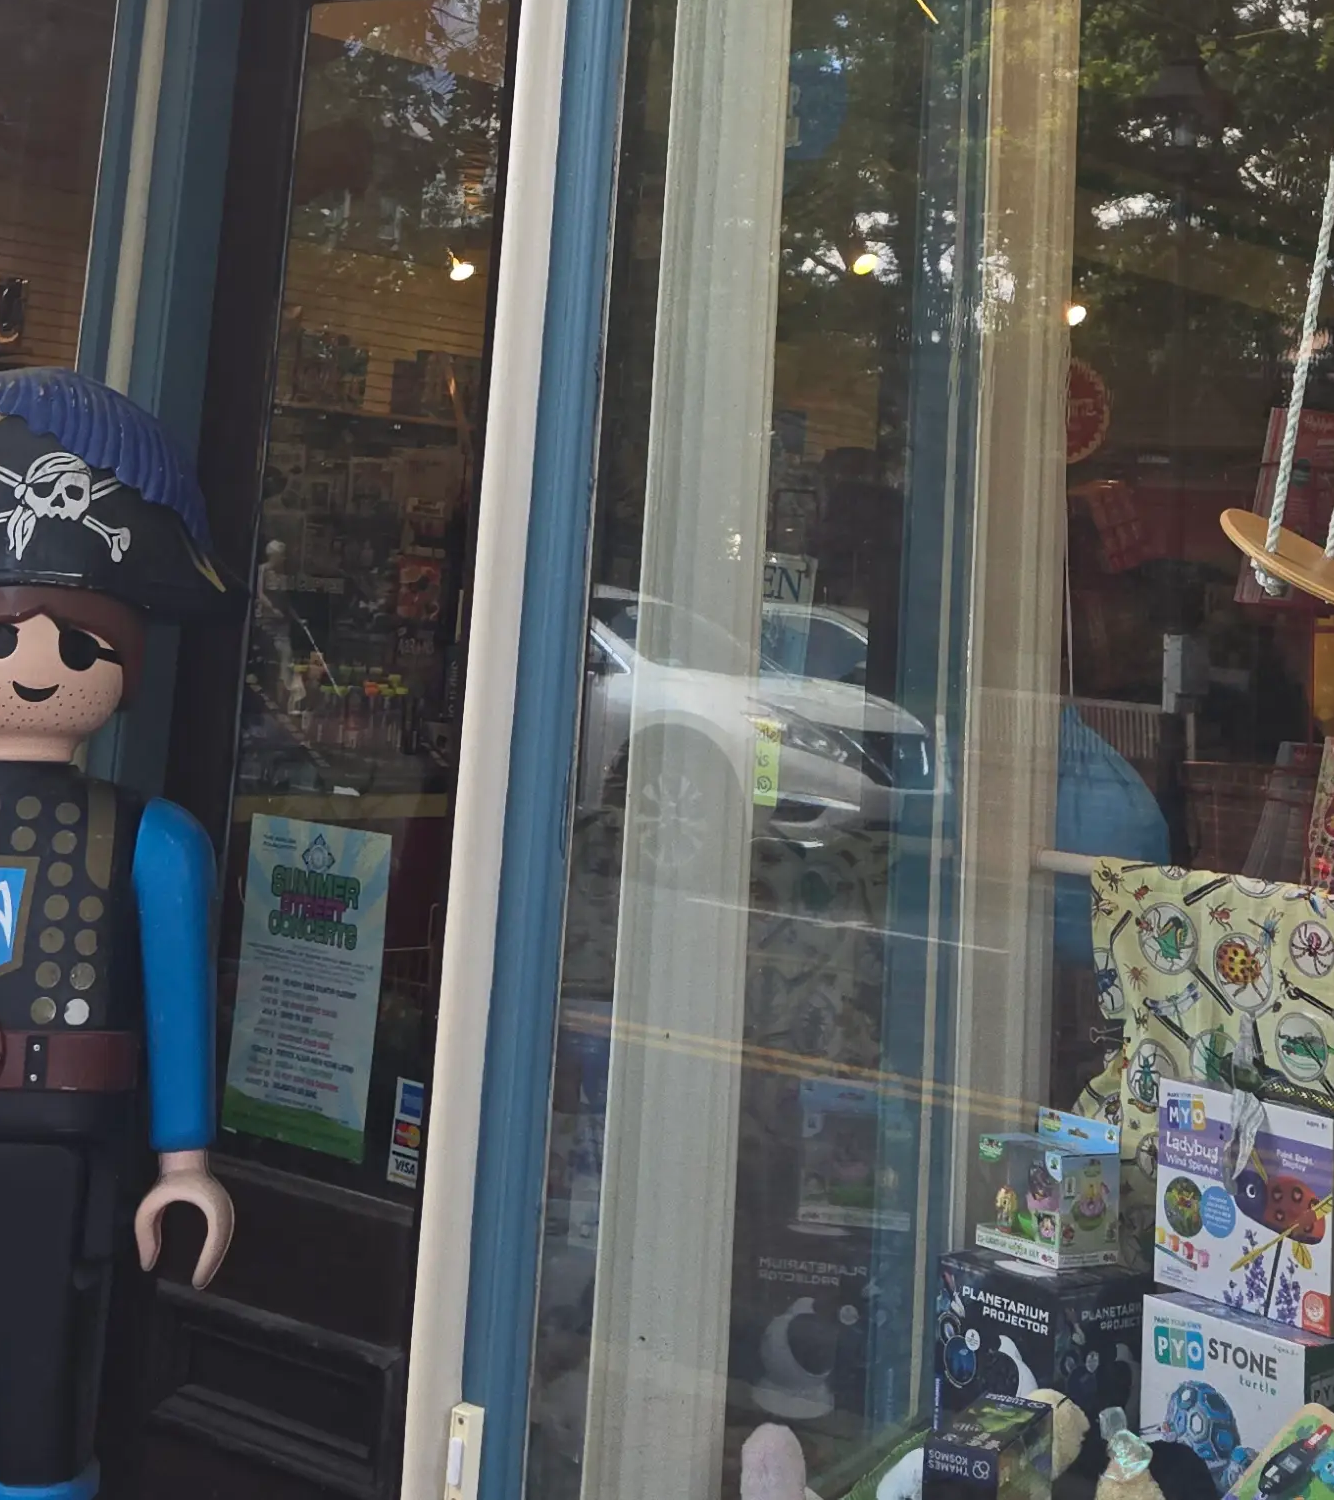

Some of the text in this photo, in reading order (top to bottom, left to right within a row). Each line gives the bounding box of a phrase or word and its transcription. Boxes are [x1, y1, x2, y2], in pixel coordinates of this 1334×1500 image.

[763, 565, 808, 602] EN
[272, 864, 361, 910] SUMMER
[280, 892, 347, 923] STREET
[268, 909, 358, 951] CONCERTS
[1168, 1105, 1206, 1128] MYO
[1166, 1131, 1219, 1163] Ladybug
[394, 1158, 416, 1175] VISA
[1165, 1152, 1220, 1178] Wind Spinner
[962, 1285, 1050, 1324] PLANETARIUM
[1081, 1301, 1141, 1322] PLANETARI
[982, 1306, 1049, 1336] PROJECTOR
[1099, 1316, 1141, 1331] PROJECT
[1157, 1336, 1203, 1363] PYO
[1207, 1337, 1278, 1381] STONE
[1239, 1374, 1277, 1396] turtle
[928, 1449, 969, 1467] KOSMOS
[928, 1459, 969, 1477] THAMES
